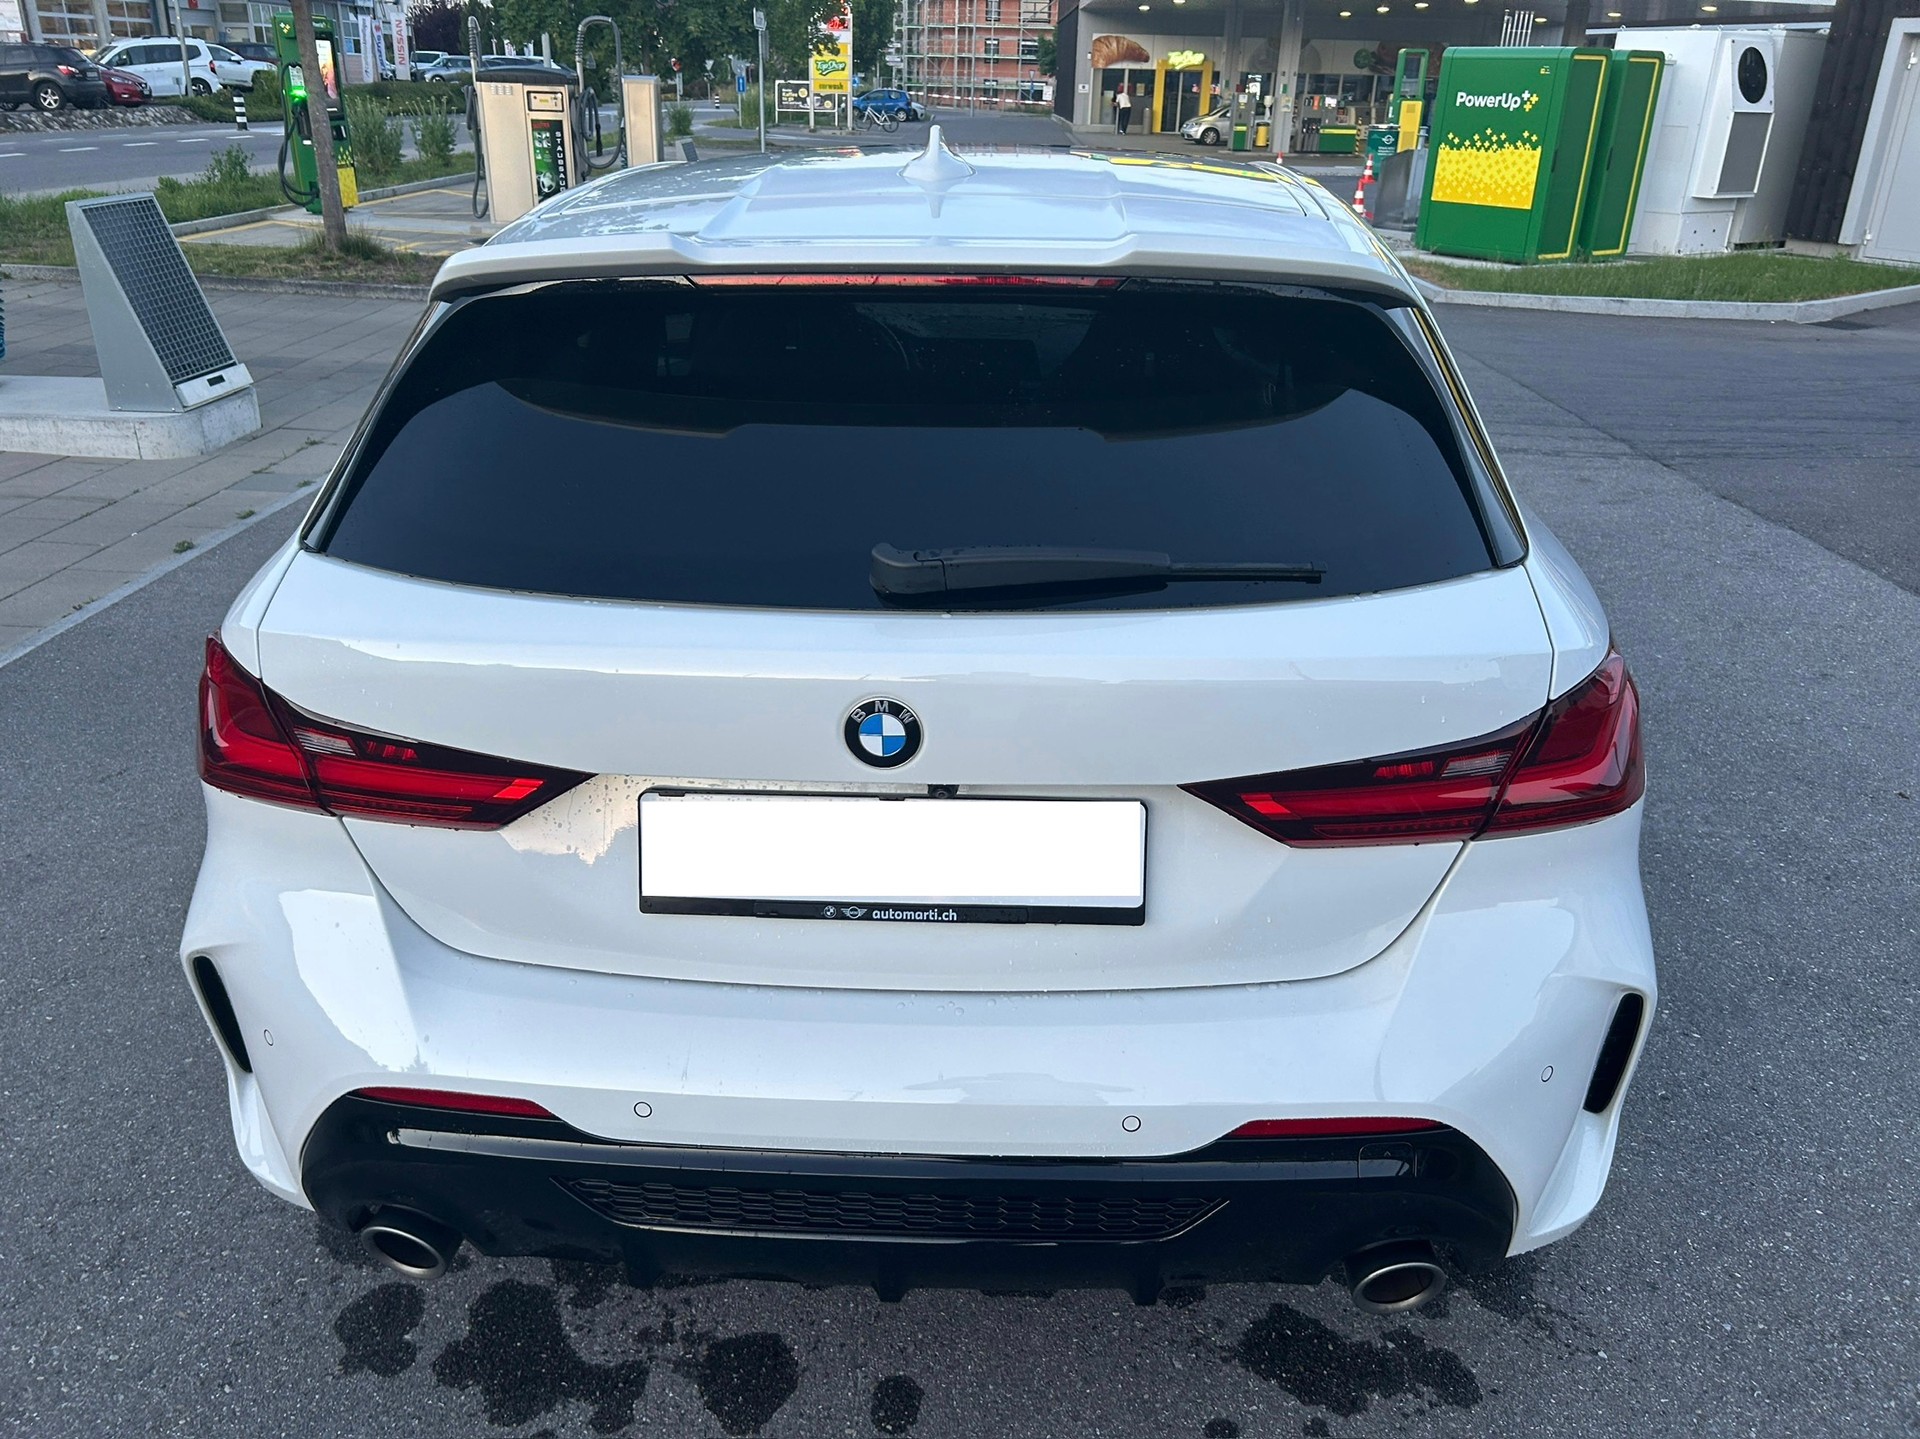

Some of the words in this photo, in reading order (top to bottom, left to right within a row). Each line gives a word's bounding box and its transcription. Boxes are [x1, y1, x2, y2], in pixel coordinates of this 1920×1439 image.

[395, 19, 406, 66] NISSAN
[1456, 92, 1521, 111] PowerUp
[851, 700, 916, 724] BMW
[872, 908, 957, 921] automarti.ch
